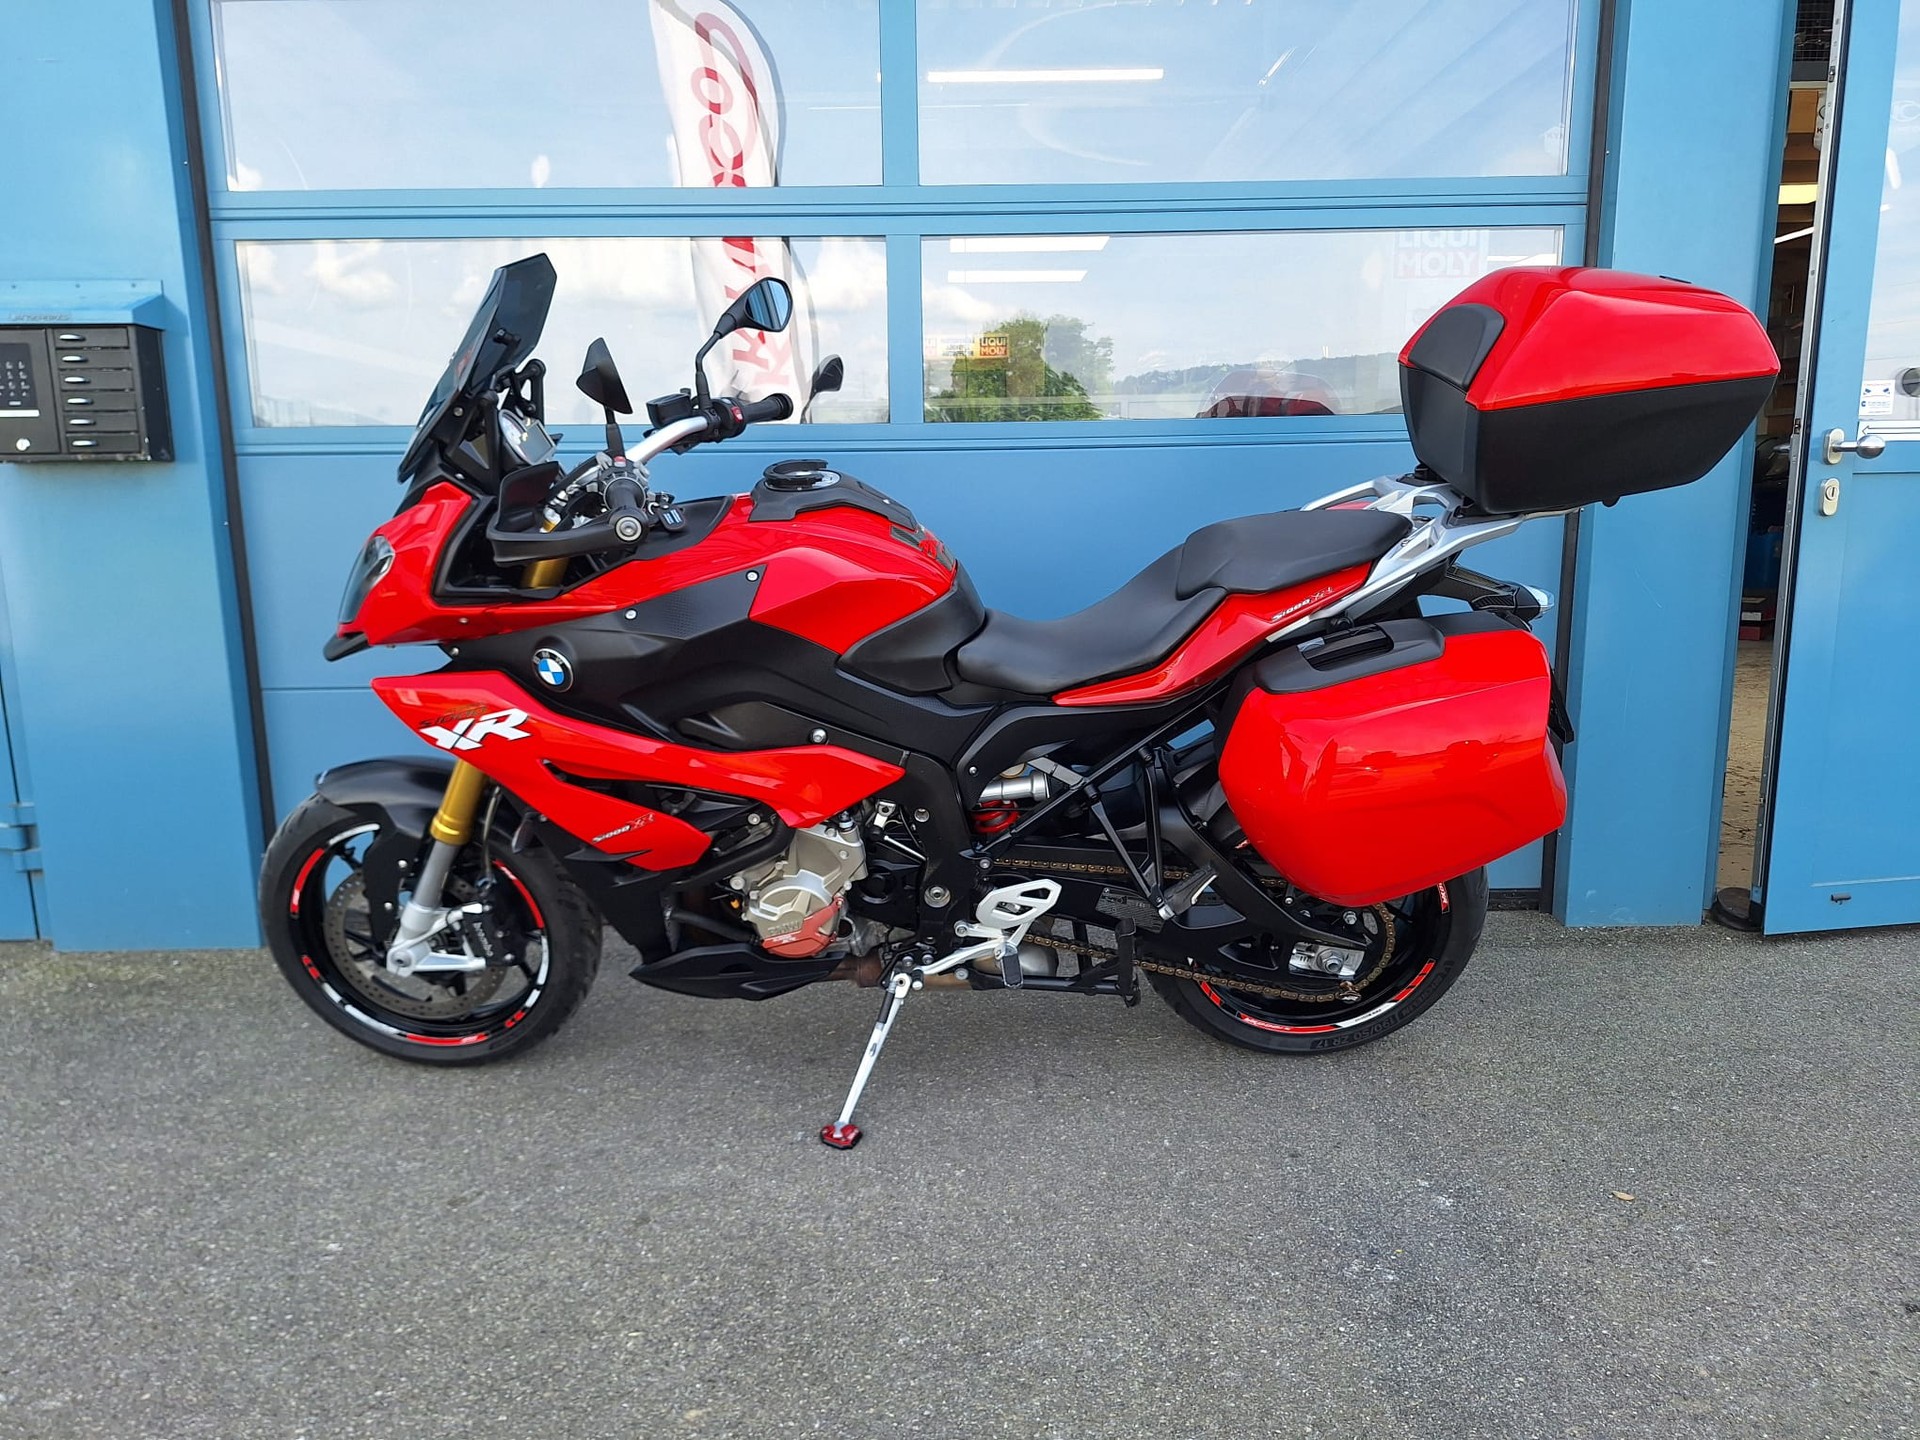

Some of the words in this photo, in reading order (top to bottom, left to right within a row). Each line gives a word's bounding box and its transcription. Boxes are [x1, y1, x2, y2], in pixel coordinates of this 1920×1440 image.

[1397, 251, 1479, 277] MOLY
[981, 337, 1006, 347] LIQUI
[980, 347, 1007, 356] MOLY
[532, 651, 564, 665] BMW
[419, 707, 533, 751] XR
